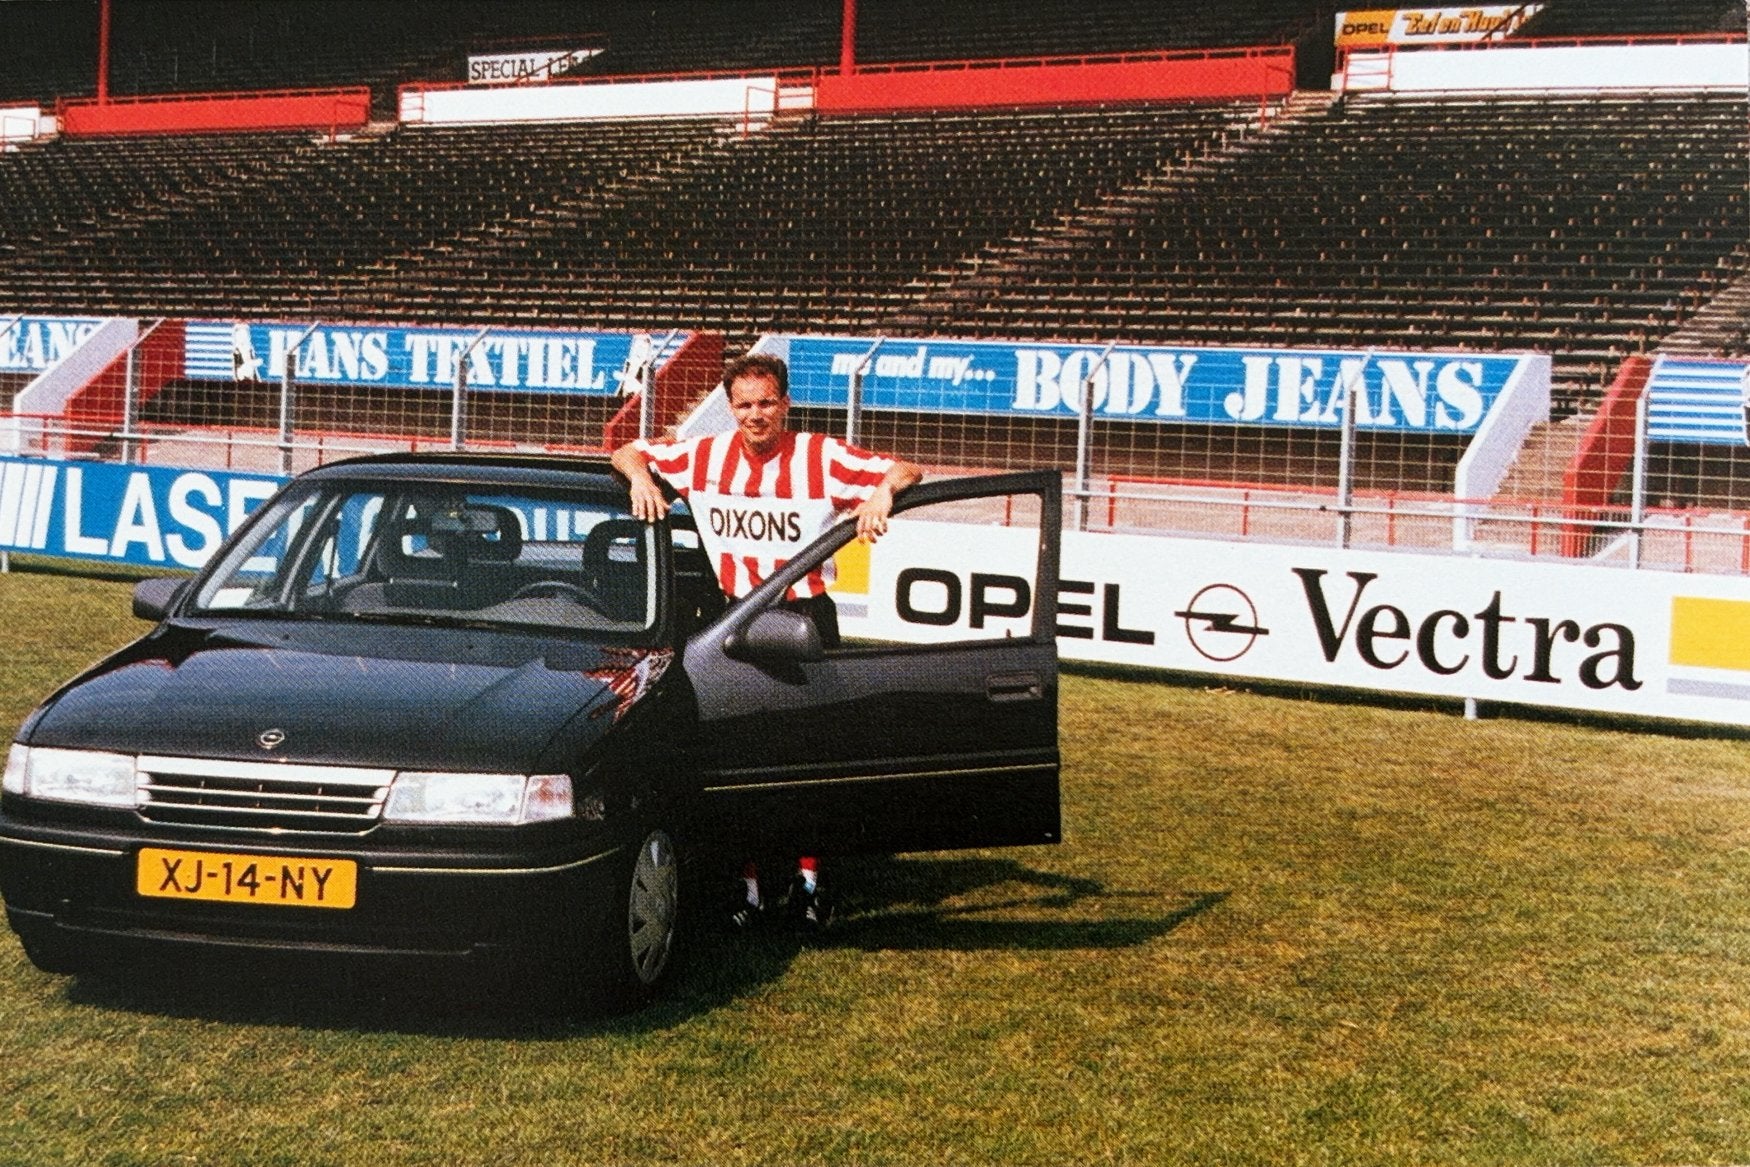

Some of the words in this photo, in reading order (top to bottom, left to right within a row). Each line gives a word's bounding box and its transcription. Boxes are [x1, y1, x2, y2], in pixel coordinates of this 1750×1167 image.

[1342, 21, 1390, 36] OPEL
[470, 58, 540, 81] SPECIAL
[267, 330, 389, 380] HANS
[405, 333, 604, 390] TEXTIEL
[875, 345, 927, 378] and
[1011, 348, 1198, 416] BODY
[1224, 355, 1484, 430] JEANS
[710, 507, 801, 542] DIXONS
[895, 567, 1155, 645] OPEL
[1291, 567, 1644, 691] Vectra
[159, 857, 333, 901] XJ-14-NY
